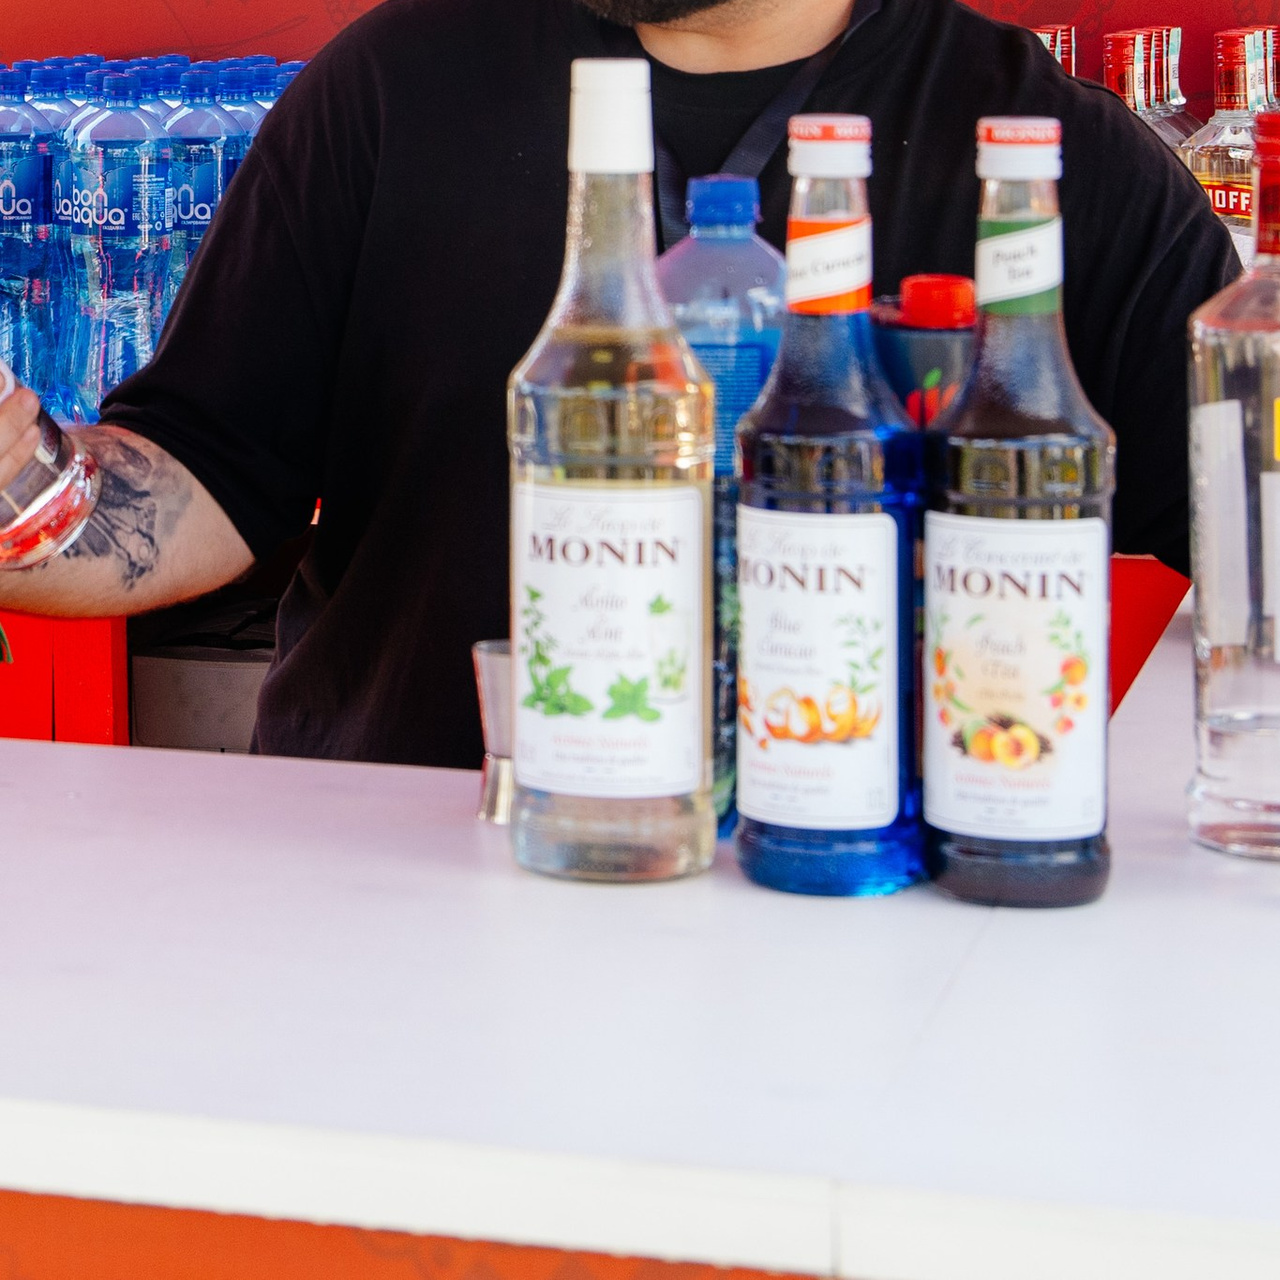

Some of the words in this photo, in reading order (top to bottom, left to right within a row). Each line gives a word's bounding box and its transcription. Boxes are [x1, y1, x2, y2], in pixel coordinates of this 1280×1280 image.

[72, 184, 108, 206] bon
[72, 206, 125, 228] aqua
[529, 533, 680, 567] MONIN
[933, 563, 1085, 599] MONIN
